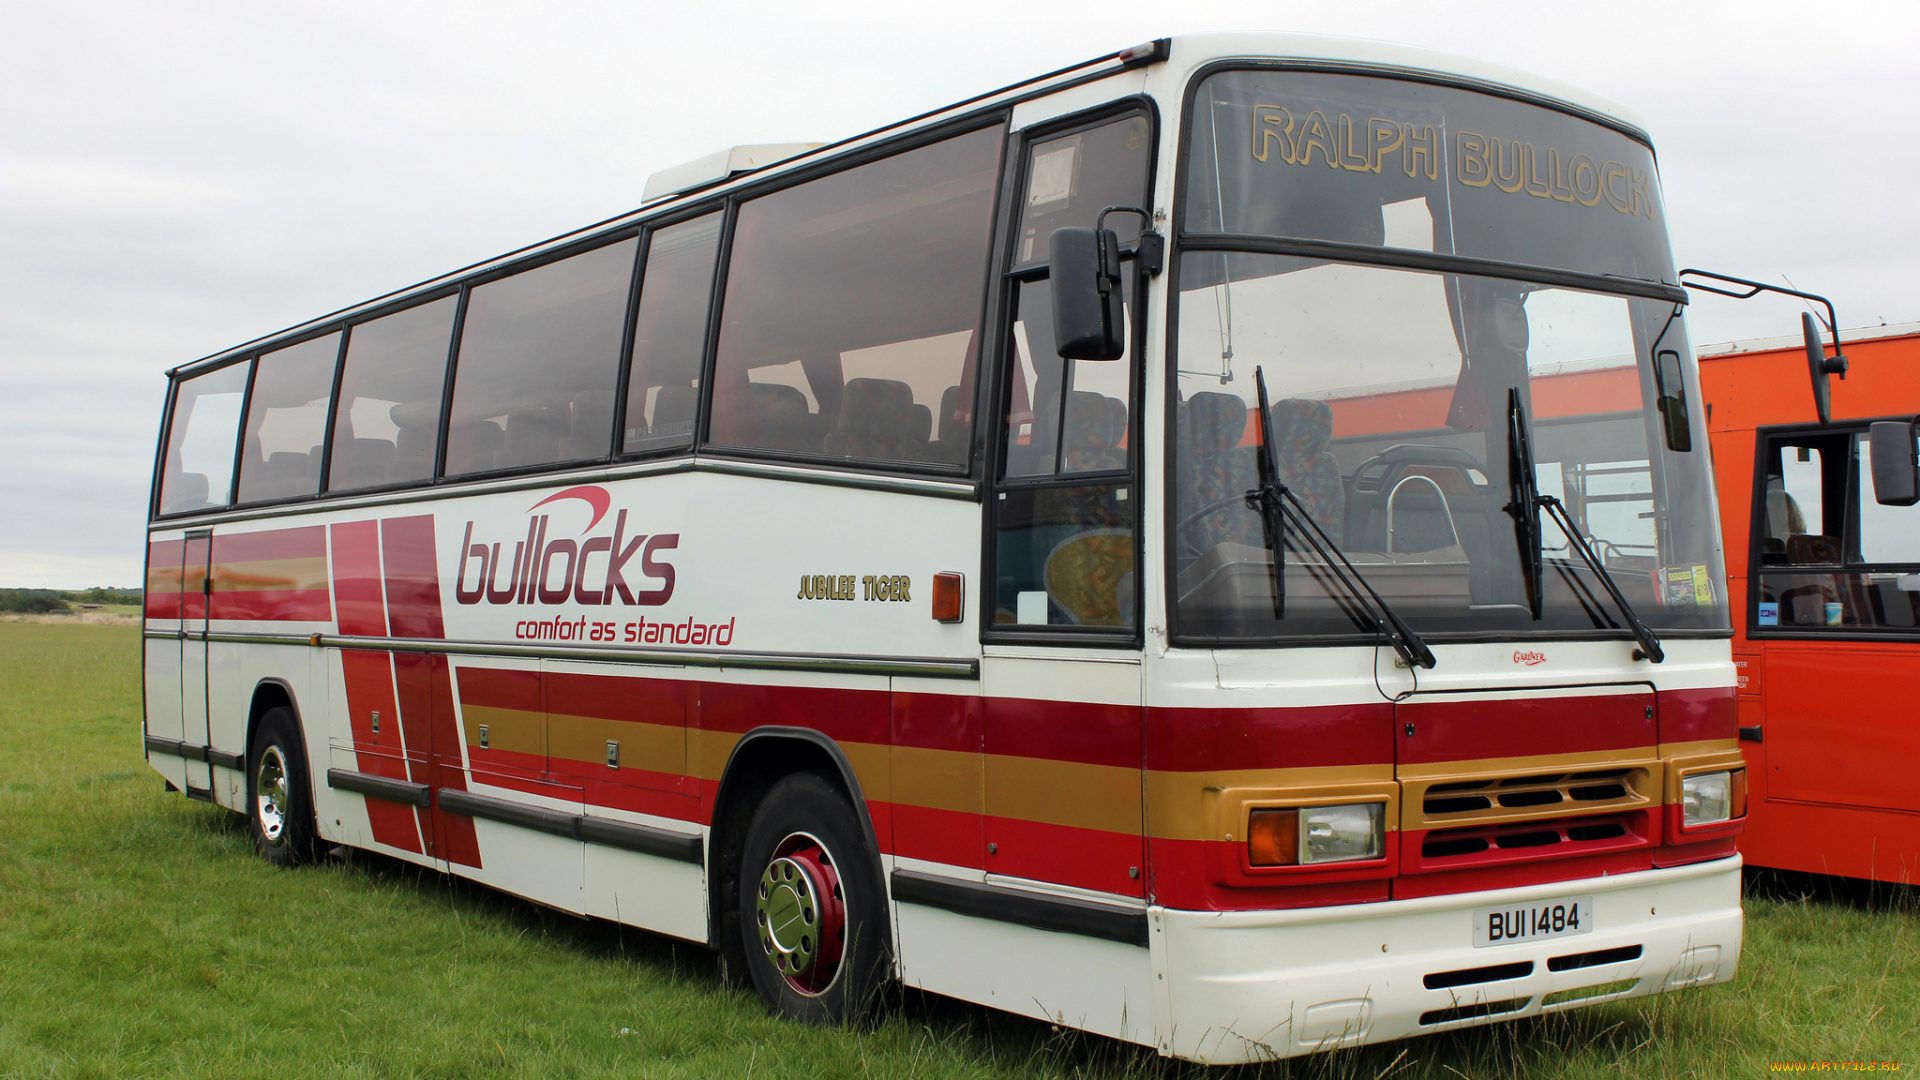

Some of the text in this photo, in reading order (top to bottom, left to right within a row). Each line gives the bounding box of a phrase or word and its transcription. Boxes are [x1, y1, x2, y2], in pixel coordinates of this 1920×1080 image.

[1252, 104, 1655, 219] RALPH BULLOCK
[456, 508, 680, 606] bullocks
[797, 575, 911, 602] JUBILEE TIGER
[515, 614, 736, 646] comfort as standard
[1513, 650, 1546, 664] GARDNER
[1737, 675, 1749, 683] REEN
[1489, 902, 1580, 941] BUI 1484
